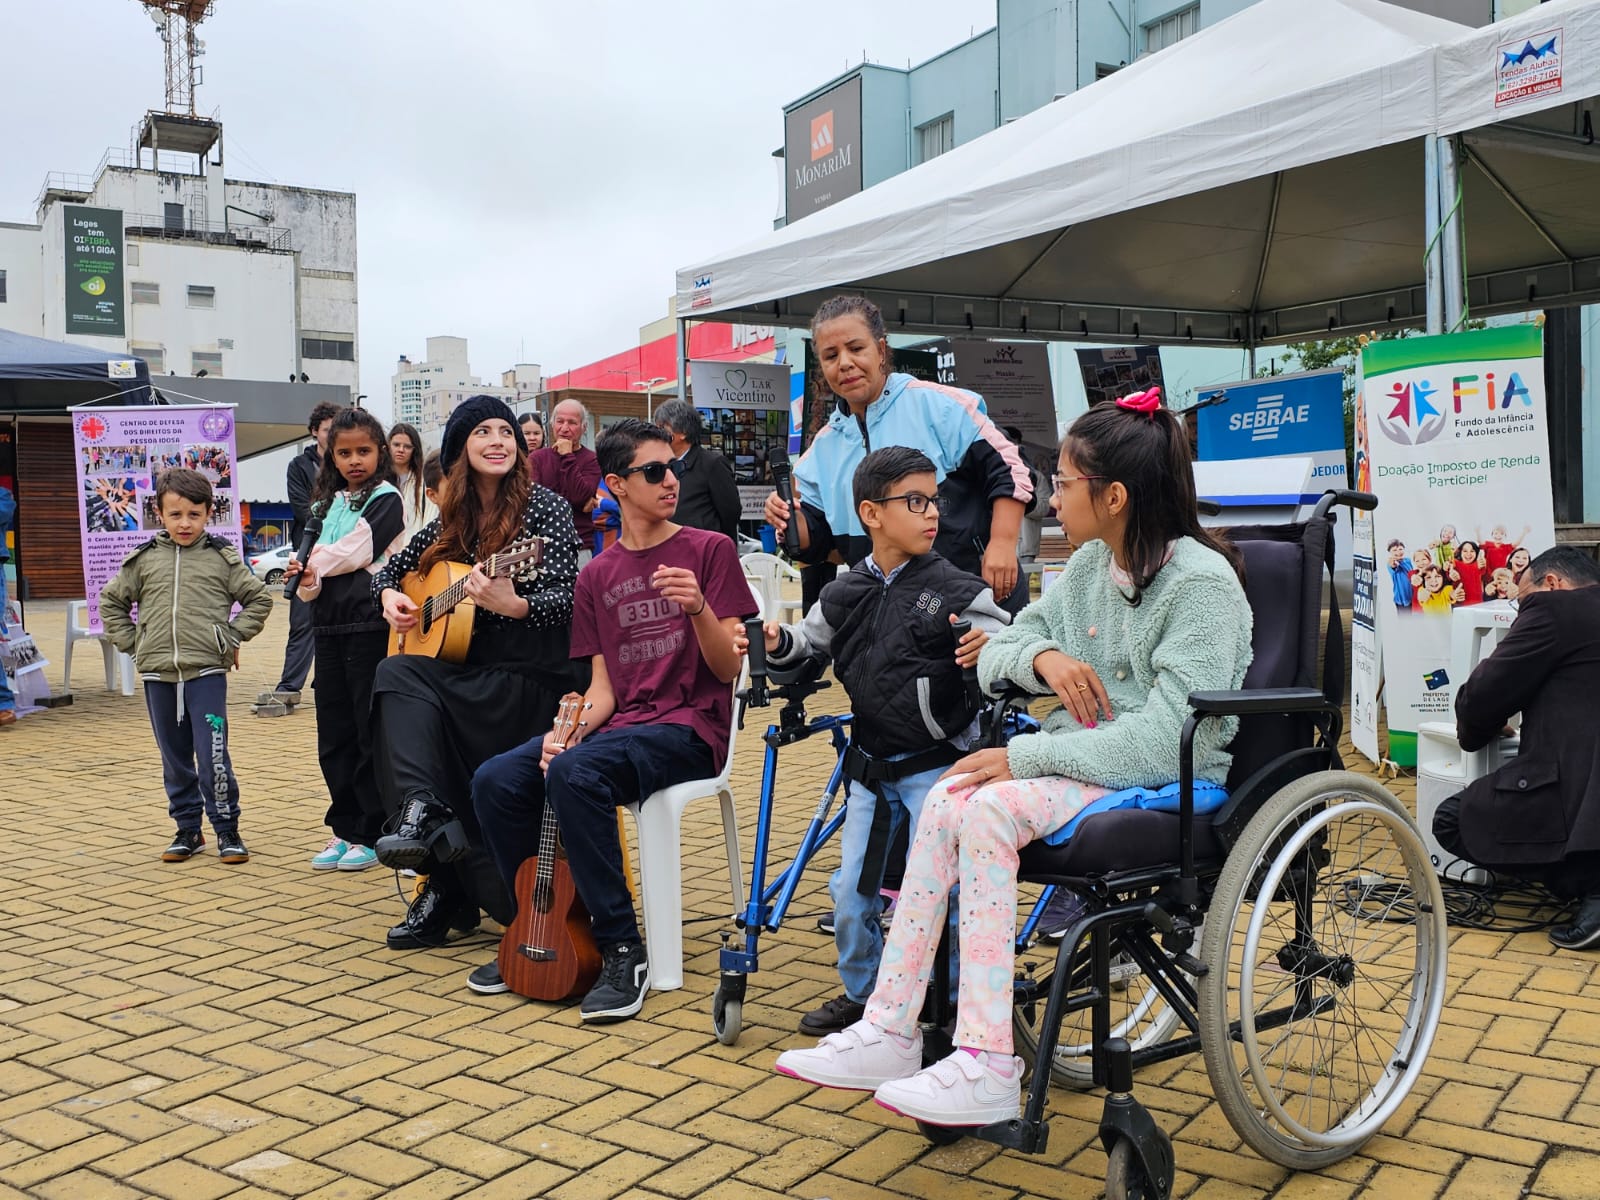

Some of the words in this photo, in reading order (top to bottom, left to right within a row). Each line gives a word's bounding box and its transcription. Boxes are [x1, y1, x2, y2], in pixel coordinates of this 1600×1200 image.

[1501, 67, 1528, 79] Tendas
[1497, 88, 1527, 102] LOCAÇÃO
[1533, 80, 1559, 91] VENDAS
[88, 229, 105, 237] tem
[76, 245, 90, 253] até
[91, 245, 95, 254] 1
[96, 245, 116, 255] GIGA
[88, 279, 100, 291] oi
[752, 380, 772, 390] LAR
[716, 388, 776, 403] Vicentino
[1229, 404, 1310, 431] SEBRAE
[1455, 418, 1483, 427] Fundo
[1485, 416, 1496, 425] da
[1498, 412, 1534, 423] Infância
[1466, 424, 1535, 438] Adolescência
[1378, 463, 1424, 477] Doação
[1427, 460, 1478, 475] Imposto
[1481, 458, 1496, 469] de
[1498, 454, 1541, 469] Renda
[1427, 474, 1488, 488] Participe!
[627, 598, 670, 622] 3310
[916, 592, 942, 615] 98
